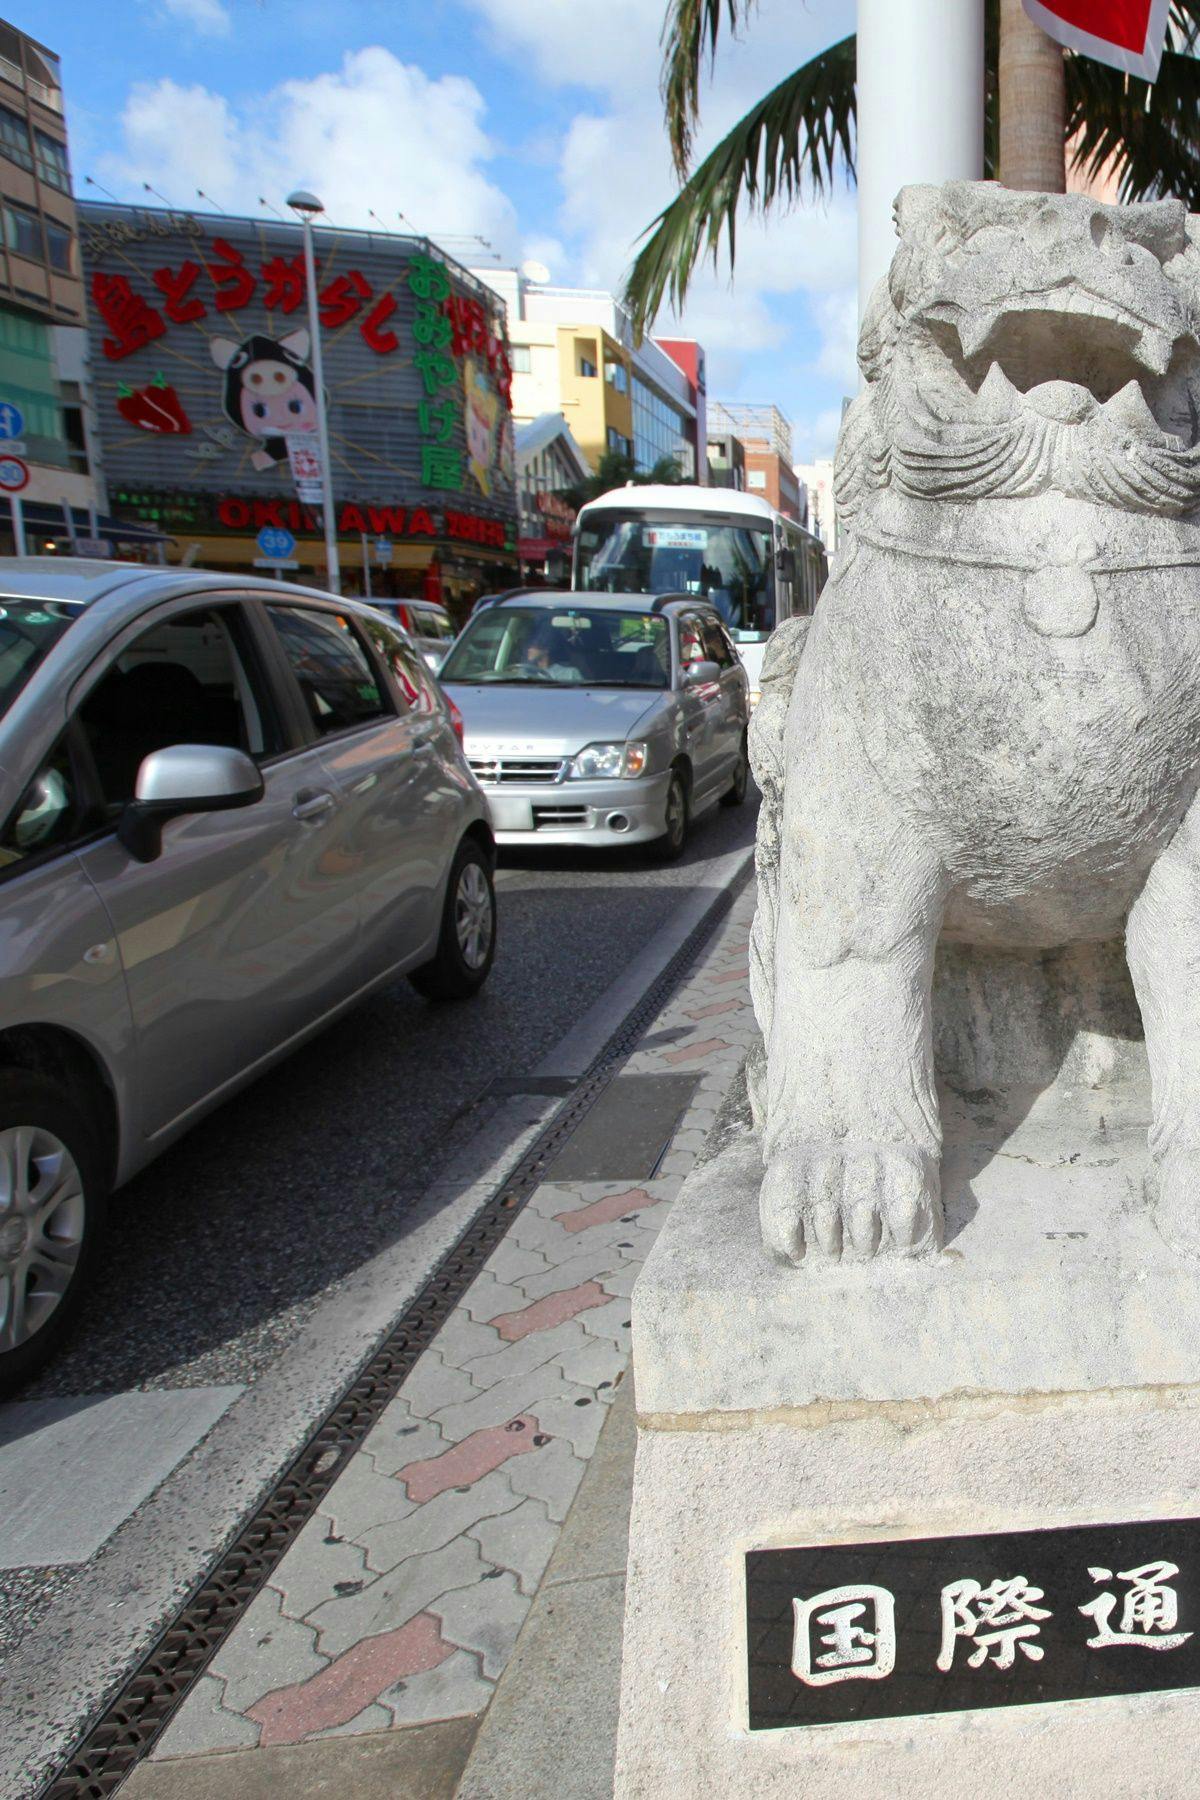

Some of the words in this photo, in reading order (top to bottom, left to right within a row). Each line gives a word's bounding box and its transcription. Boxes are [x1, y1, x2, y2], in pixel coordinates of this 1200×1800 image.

[91, 237, 400, 361] 島とうがらし
[264, 536, 288, 549] 39
